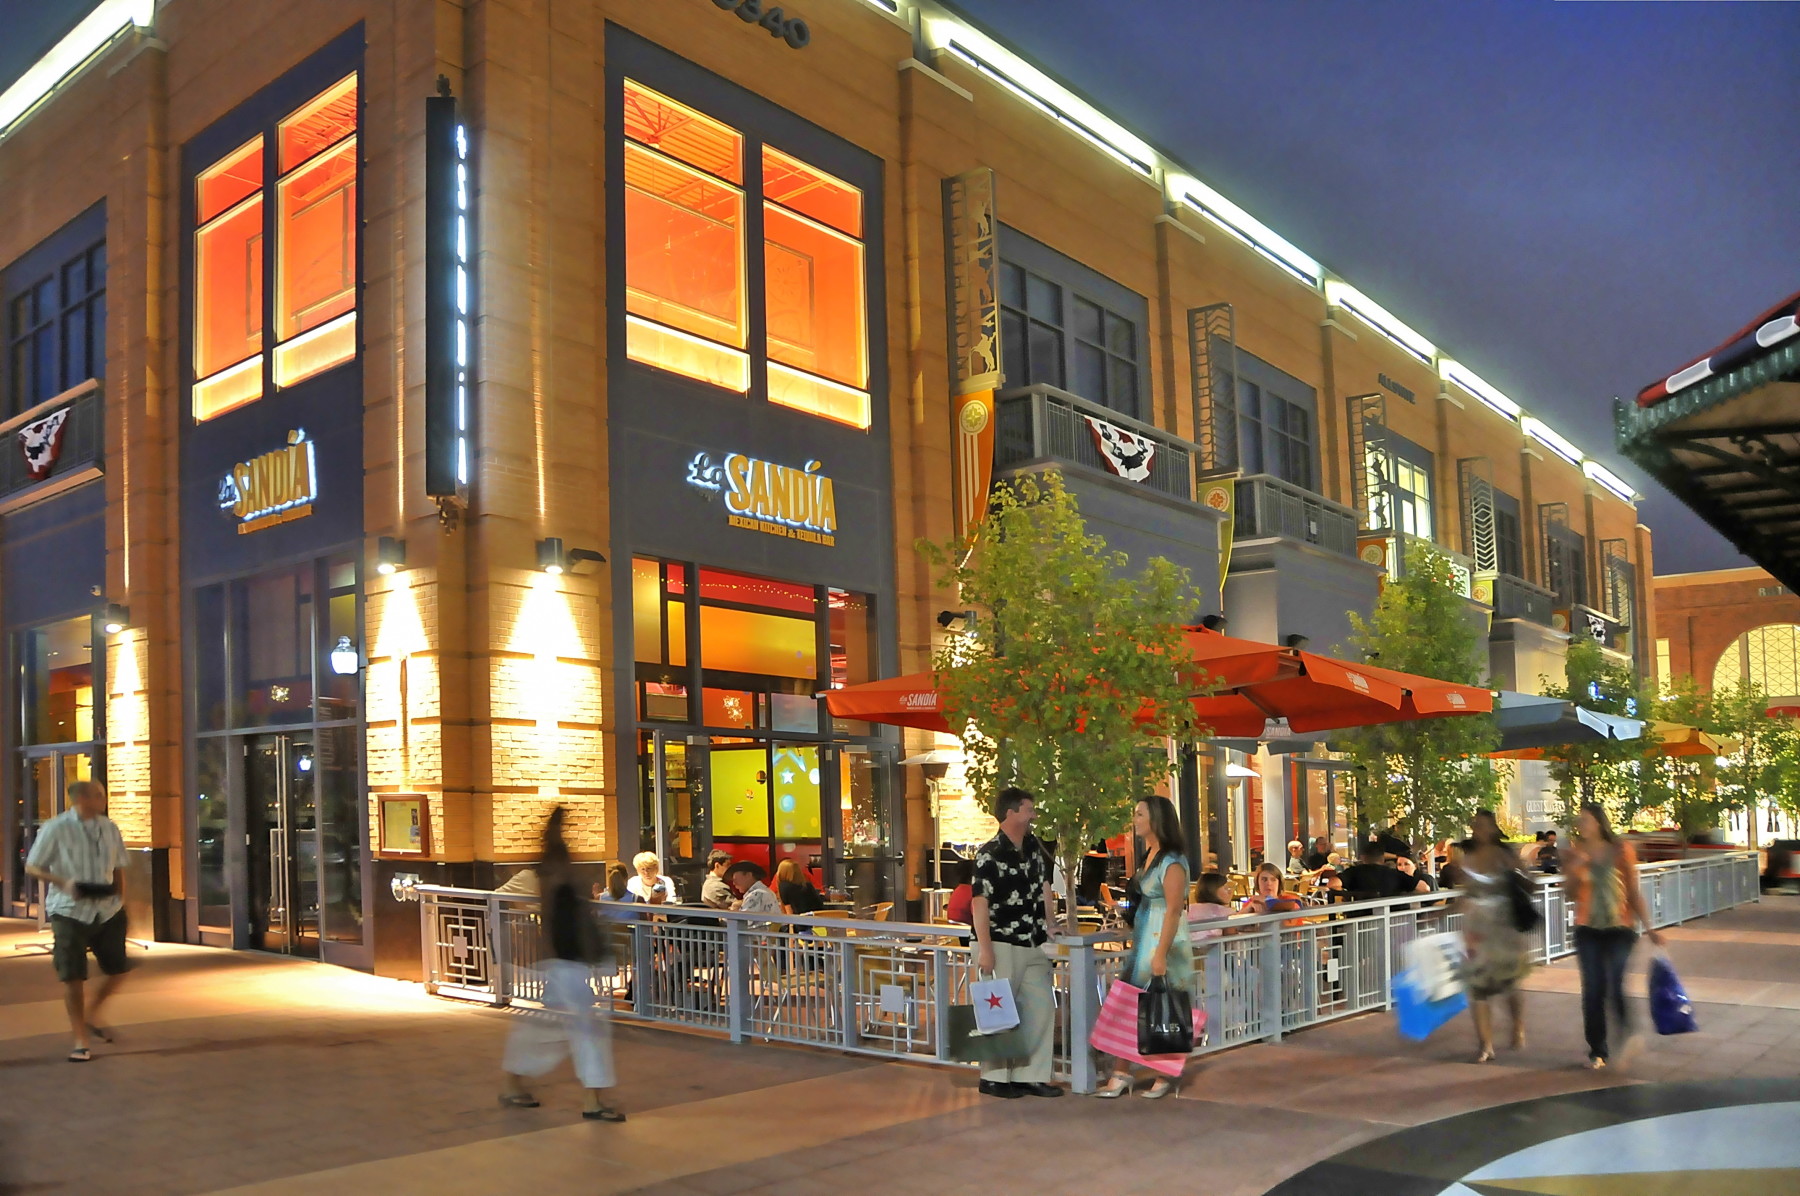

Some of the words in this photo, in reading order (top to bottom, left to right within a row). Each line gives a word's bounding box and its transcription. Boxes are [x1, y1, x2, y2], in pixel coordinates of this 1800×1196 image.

[234, 428, 314, 519] SANDÍA
[688, 452, 724, 488] La
[727, 454, 838, 531] SANDÍA
[788, 528, 796, 539] &
[907, 690, 937, 707] SANDÍA
